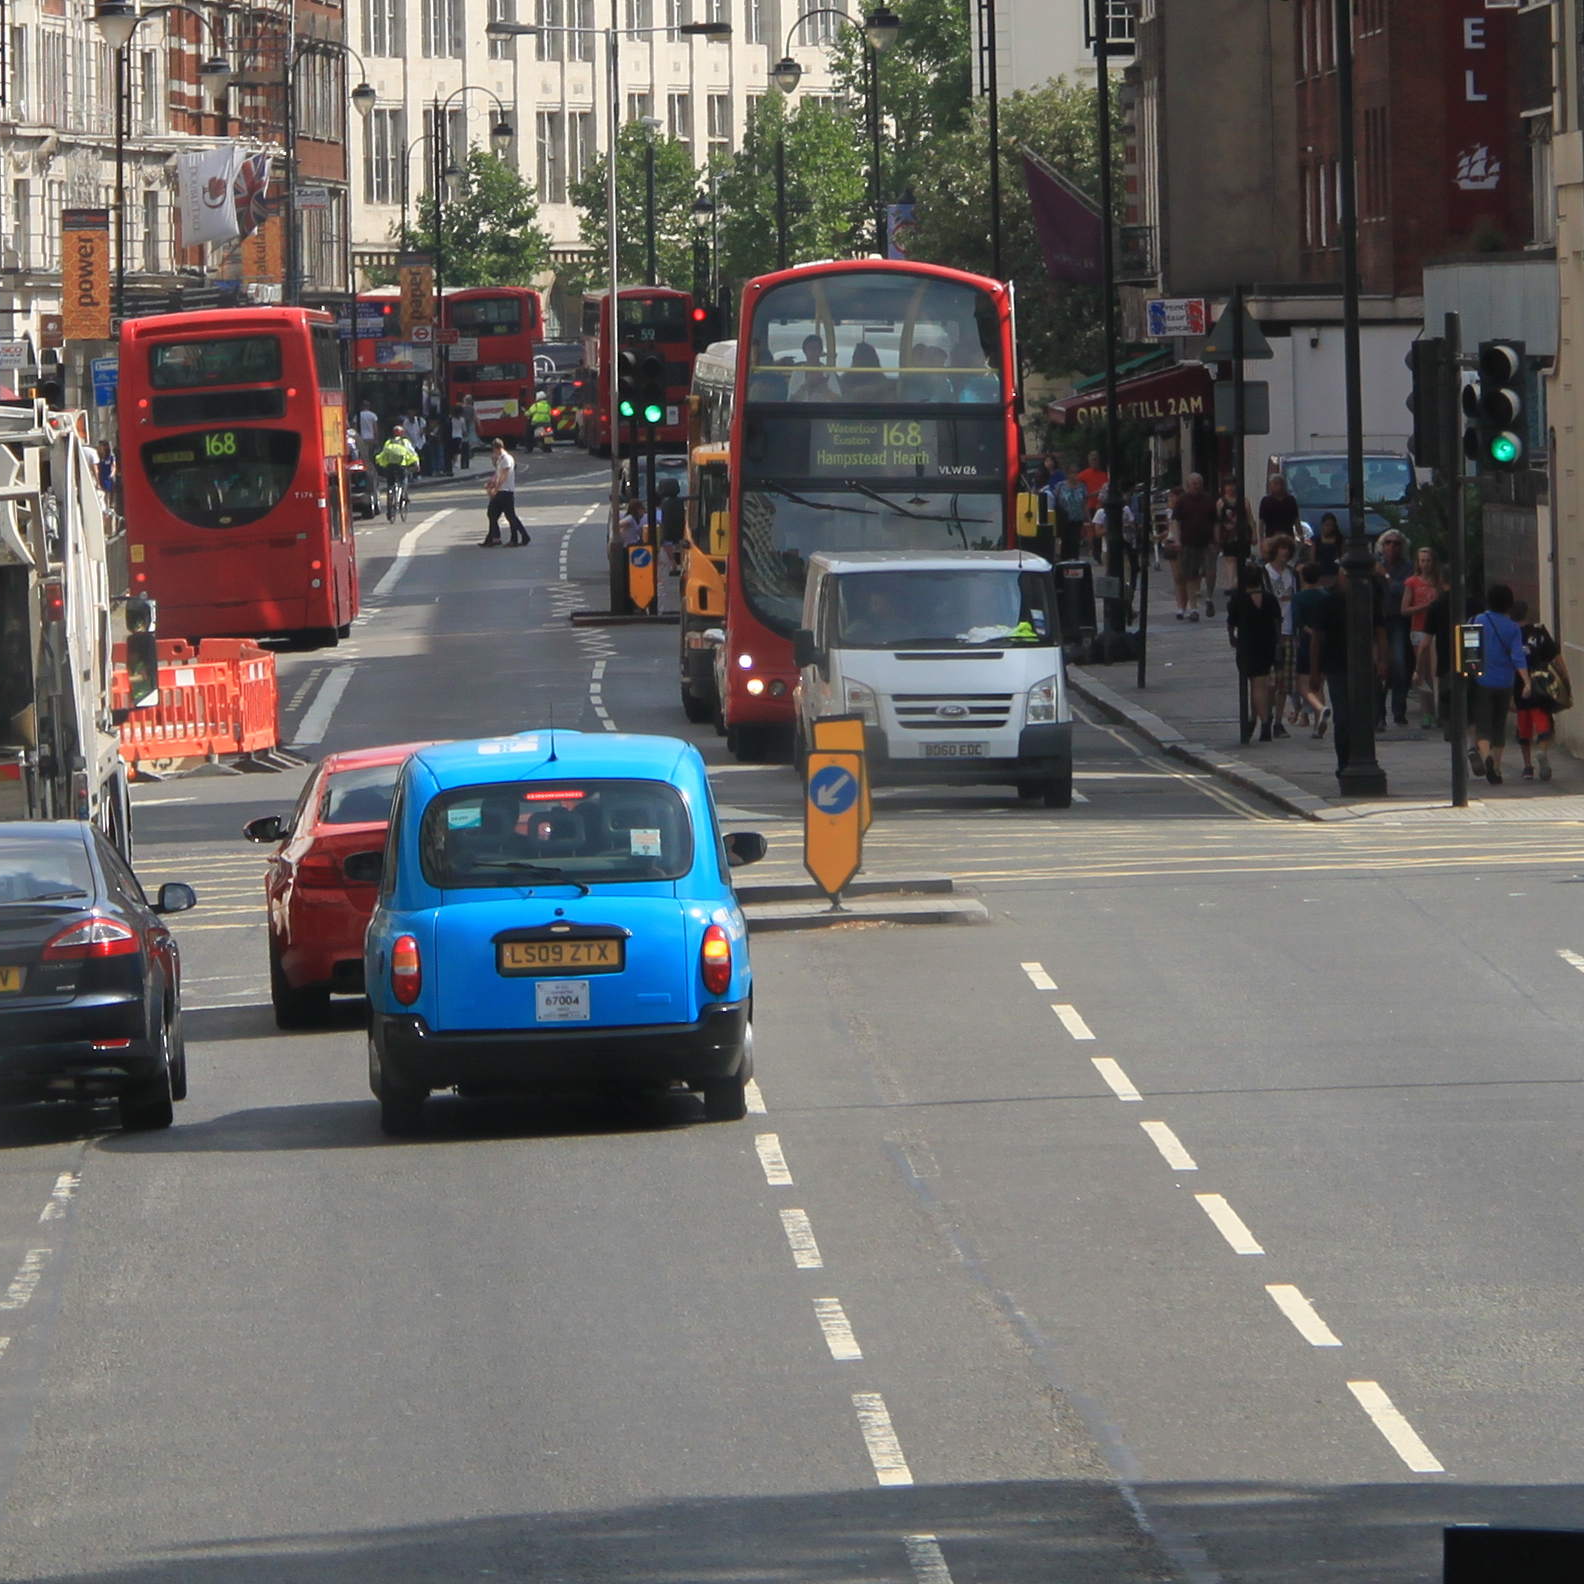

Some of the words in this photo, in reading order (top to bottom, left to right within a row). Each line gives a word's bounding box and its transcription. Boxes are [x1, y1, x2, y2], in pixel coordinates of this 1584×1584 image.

[78, 236, 100, 307] power
[410, 269, 427, 320] paper
[1168, 396, 1203, 415] 2AM
[205, 432, 236, 455] 168
[827, 423, 877, 434] Waterloo
[882, 422, 922, 447] 168
[833, 435, 870, 445] Euston
[817, 450, 887, 468] Hampstead
[893, 450, 930, 465] Heath
[510, 944, 563, 964] LS09
[570, 943, 609, 962] ZTX
[545, 995, 579, 1006] 67004
